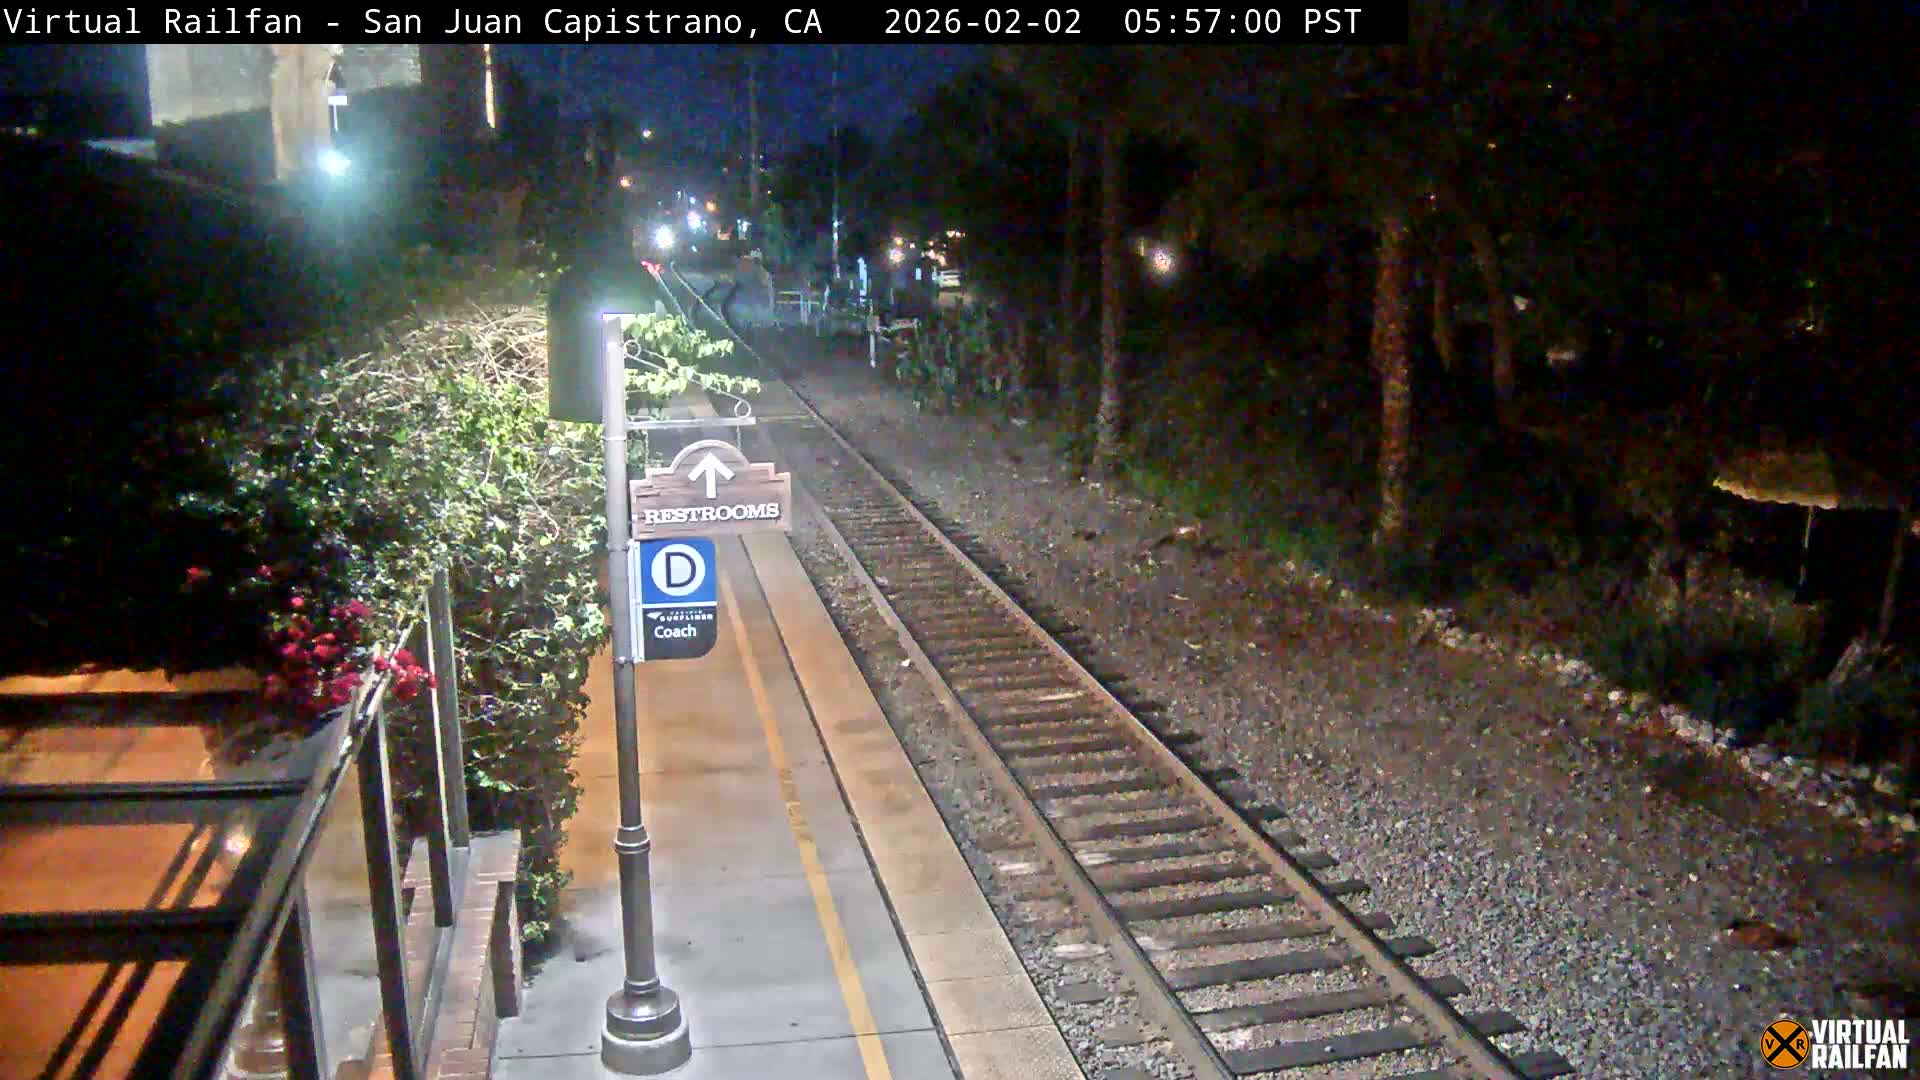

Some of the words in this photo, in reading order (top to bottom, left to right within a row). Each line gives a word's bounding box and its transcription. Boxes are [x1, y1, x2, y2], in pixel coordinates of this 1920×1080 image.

[643, 503, 779, 525] RESTROOMS
[665, 551, 696, 588] D
[654, 624, 697, 639] Coach
